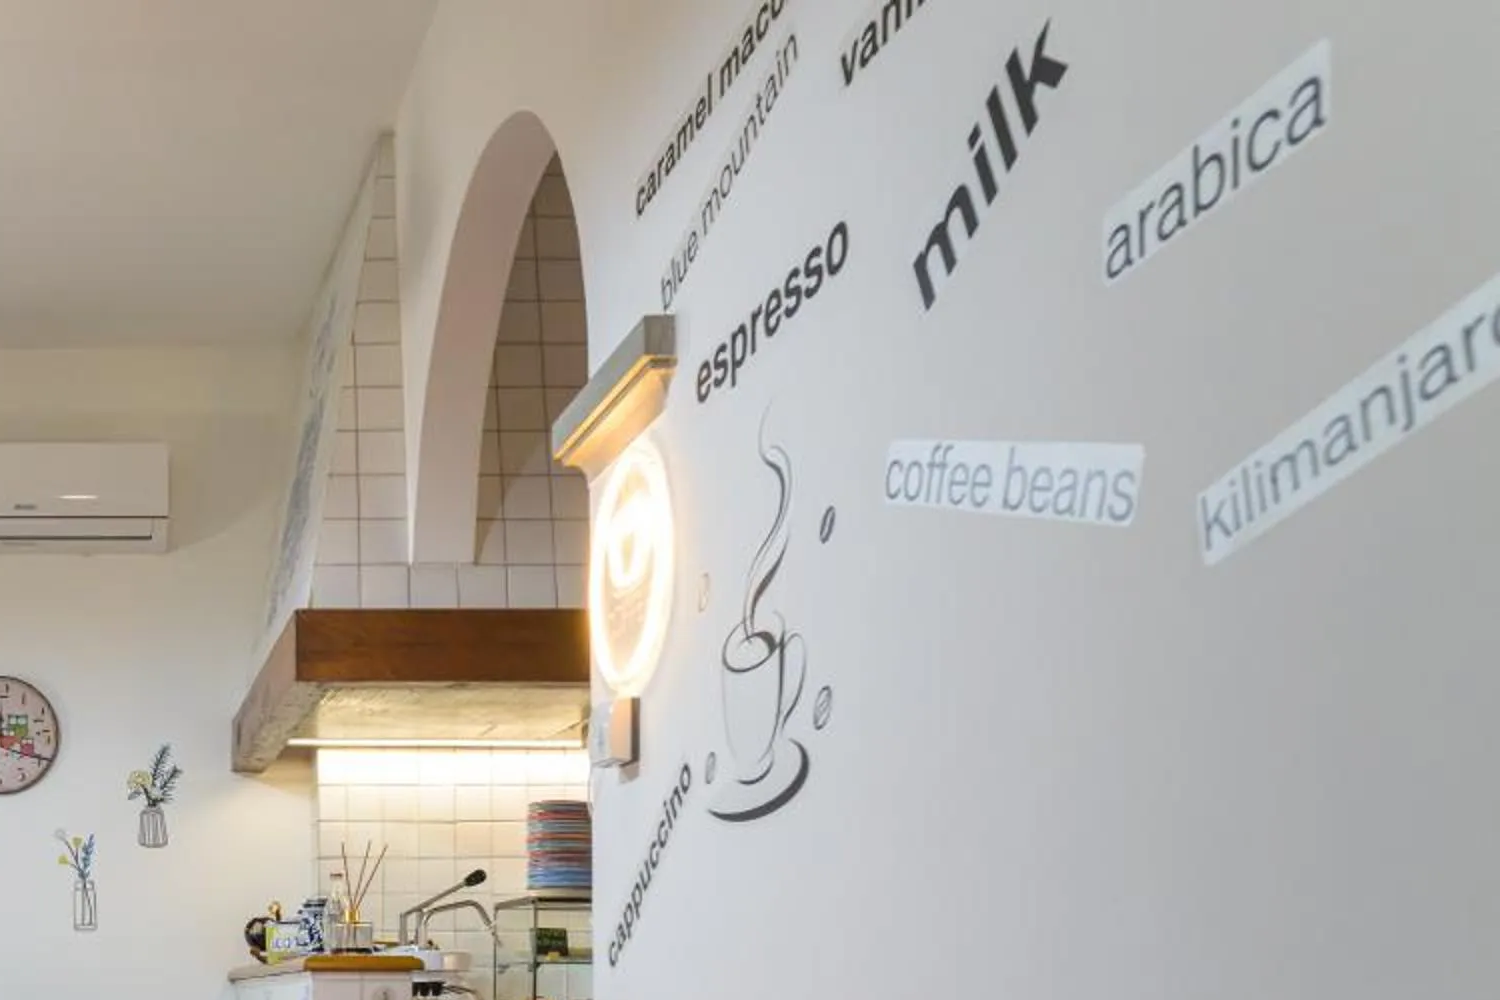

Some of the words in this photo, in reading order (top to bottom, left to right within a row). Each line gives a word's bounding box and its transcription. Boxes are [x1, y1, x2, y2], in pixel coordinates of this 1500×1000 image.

[636, 72, 713, 217] caramel
[660, 231, 700, 311] blue
[701, 34, 798, 236] mountain
[911, 18, 1068, 311] milk
[1106, 70, 1328, 281] arabica
[696, 220, 849, 403] espresso
[885, 442, 993, 508] coffee
[1001, 446, 1135, 522] beans
[1200, 303, 1500, 551] kilimanjar
[609, 763, 692, 967] cappuccino
